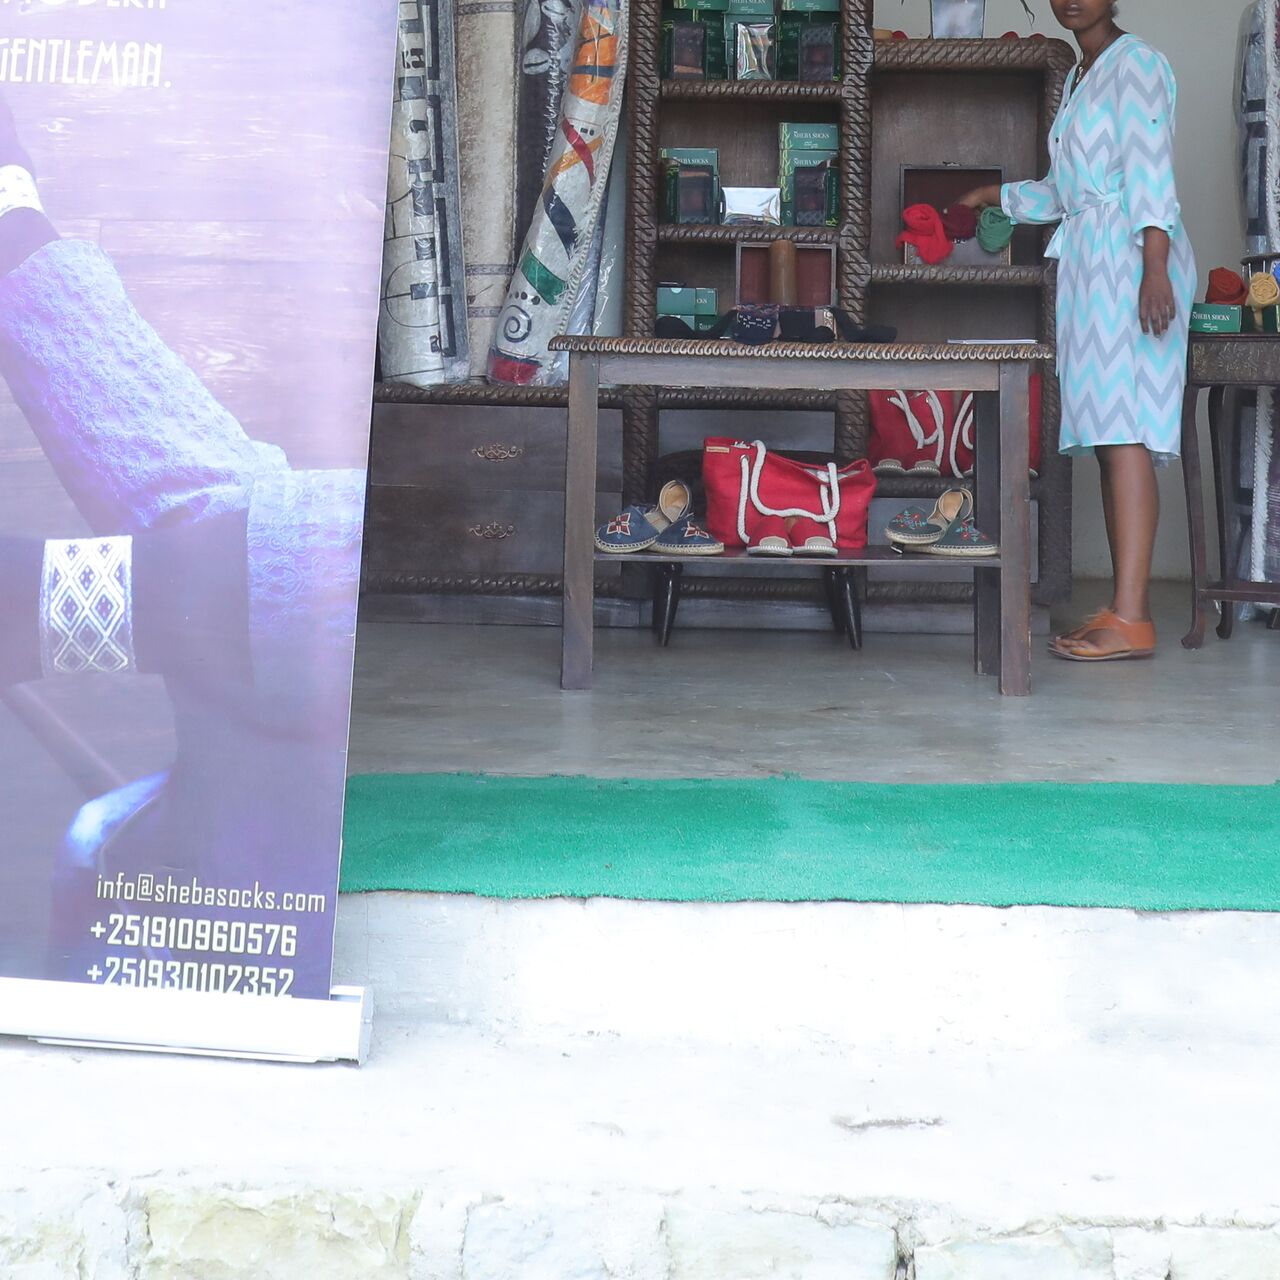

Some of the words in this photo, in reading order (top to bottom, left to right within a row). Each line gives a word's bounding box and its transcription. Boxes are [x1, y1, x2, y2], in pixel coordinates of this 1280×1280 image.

[96, 872, 326, 913] info@shebasocks.com
[90, 913, 297, 957] +251910960576
[86, 956, 295, 998] +251930102352
